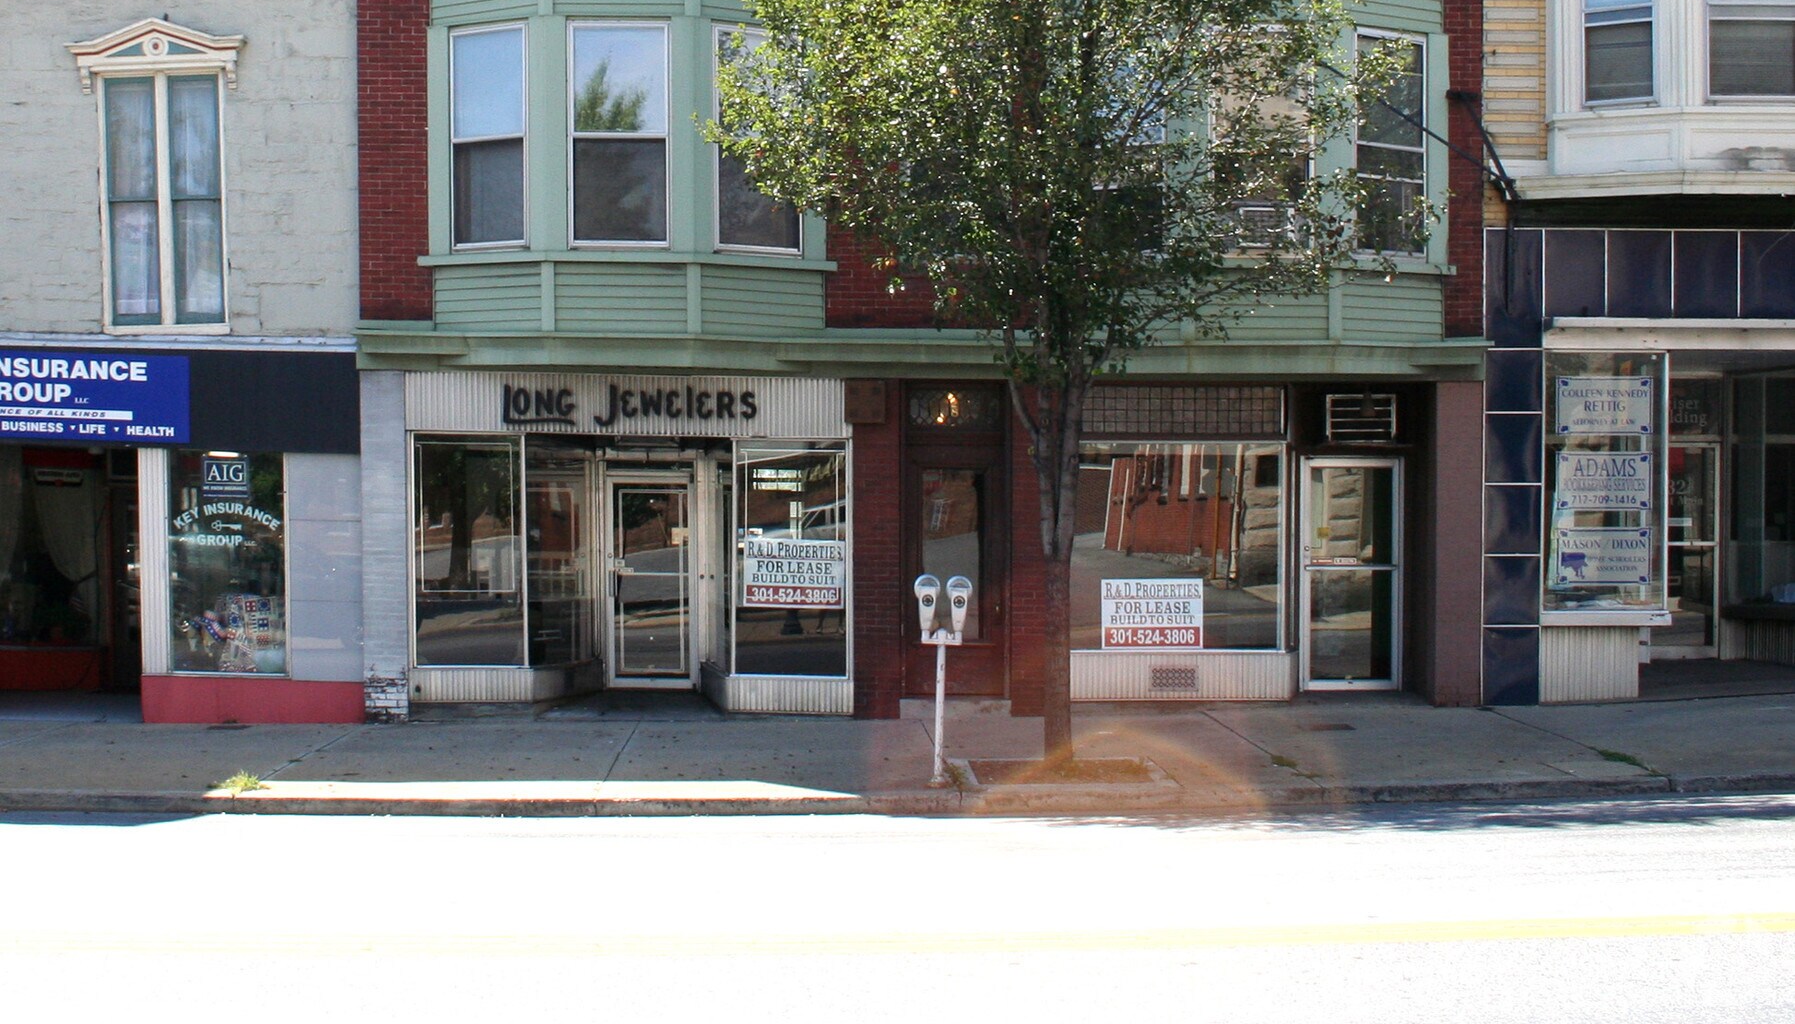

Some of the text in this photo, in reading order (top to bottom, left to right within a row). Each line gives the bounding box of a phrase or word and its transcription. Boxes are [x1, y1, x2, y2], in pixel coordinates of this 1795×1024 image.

[1562, 389, 1648, 398] COLLEEN KENNEDY
[503, 384, 576, 425] LONG
[1584, 400, 1626, 412] RETTIG
[1, 421, 175, 437] BUSINESS LIFE HEALTH
[207, 464, 244, 482] AIG
[1573, 458, 1637, 477] ADAMS
[1571, 495, 1637, 504] 717-709-1416
[173, 502, 281, 531] KEY INSURANCE
[196, 534, 243, 546] GROUP
[1562, 539, 1601, 549] MASON
[1612, 539, 1647, 549] DIXON
[748, 541, 755, 556] R
[757, 543, 764, 556] &
[757, 560, 832, 574] FOR LEASE
[752, 573, 836, 585] BUILD TO SUIT
[752, 587, 836, 603] 301-524-3806
[1105, 582, 1113, 598] R
[1115, 584, 1122, 598] &
[1114, 601, 1191, 614] FOR LEASE
[1110, 615, 1195, 624] BUILD TO SUIT
[1110, 629, 1195, 644] 301-524-3806
